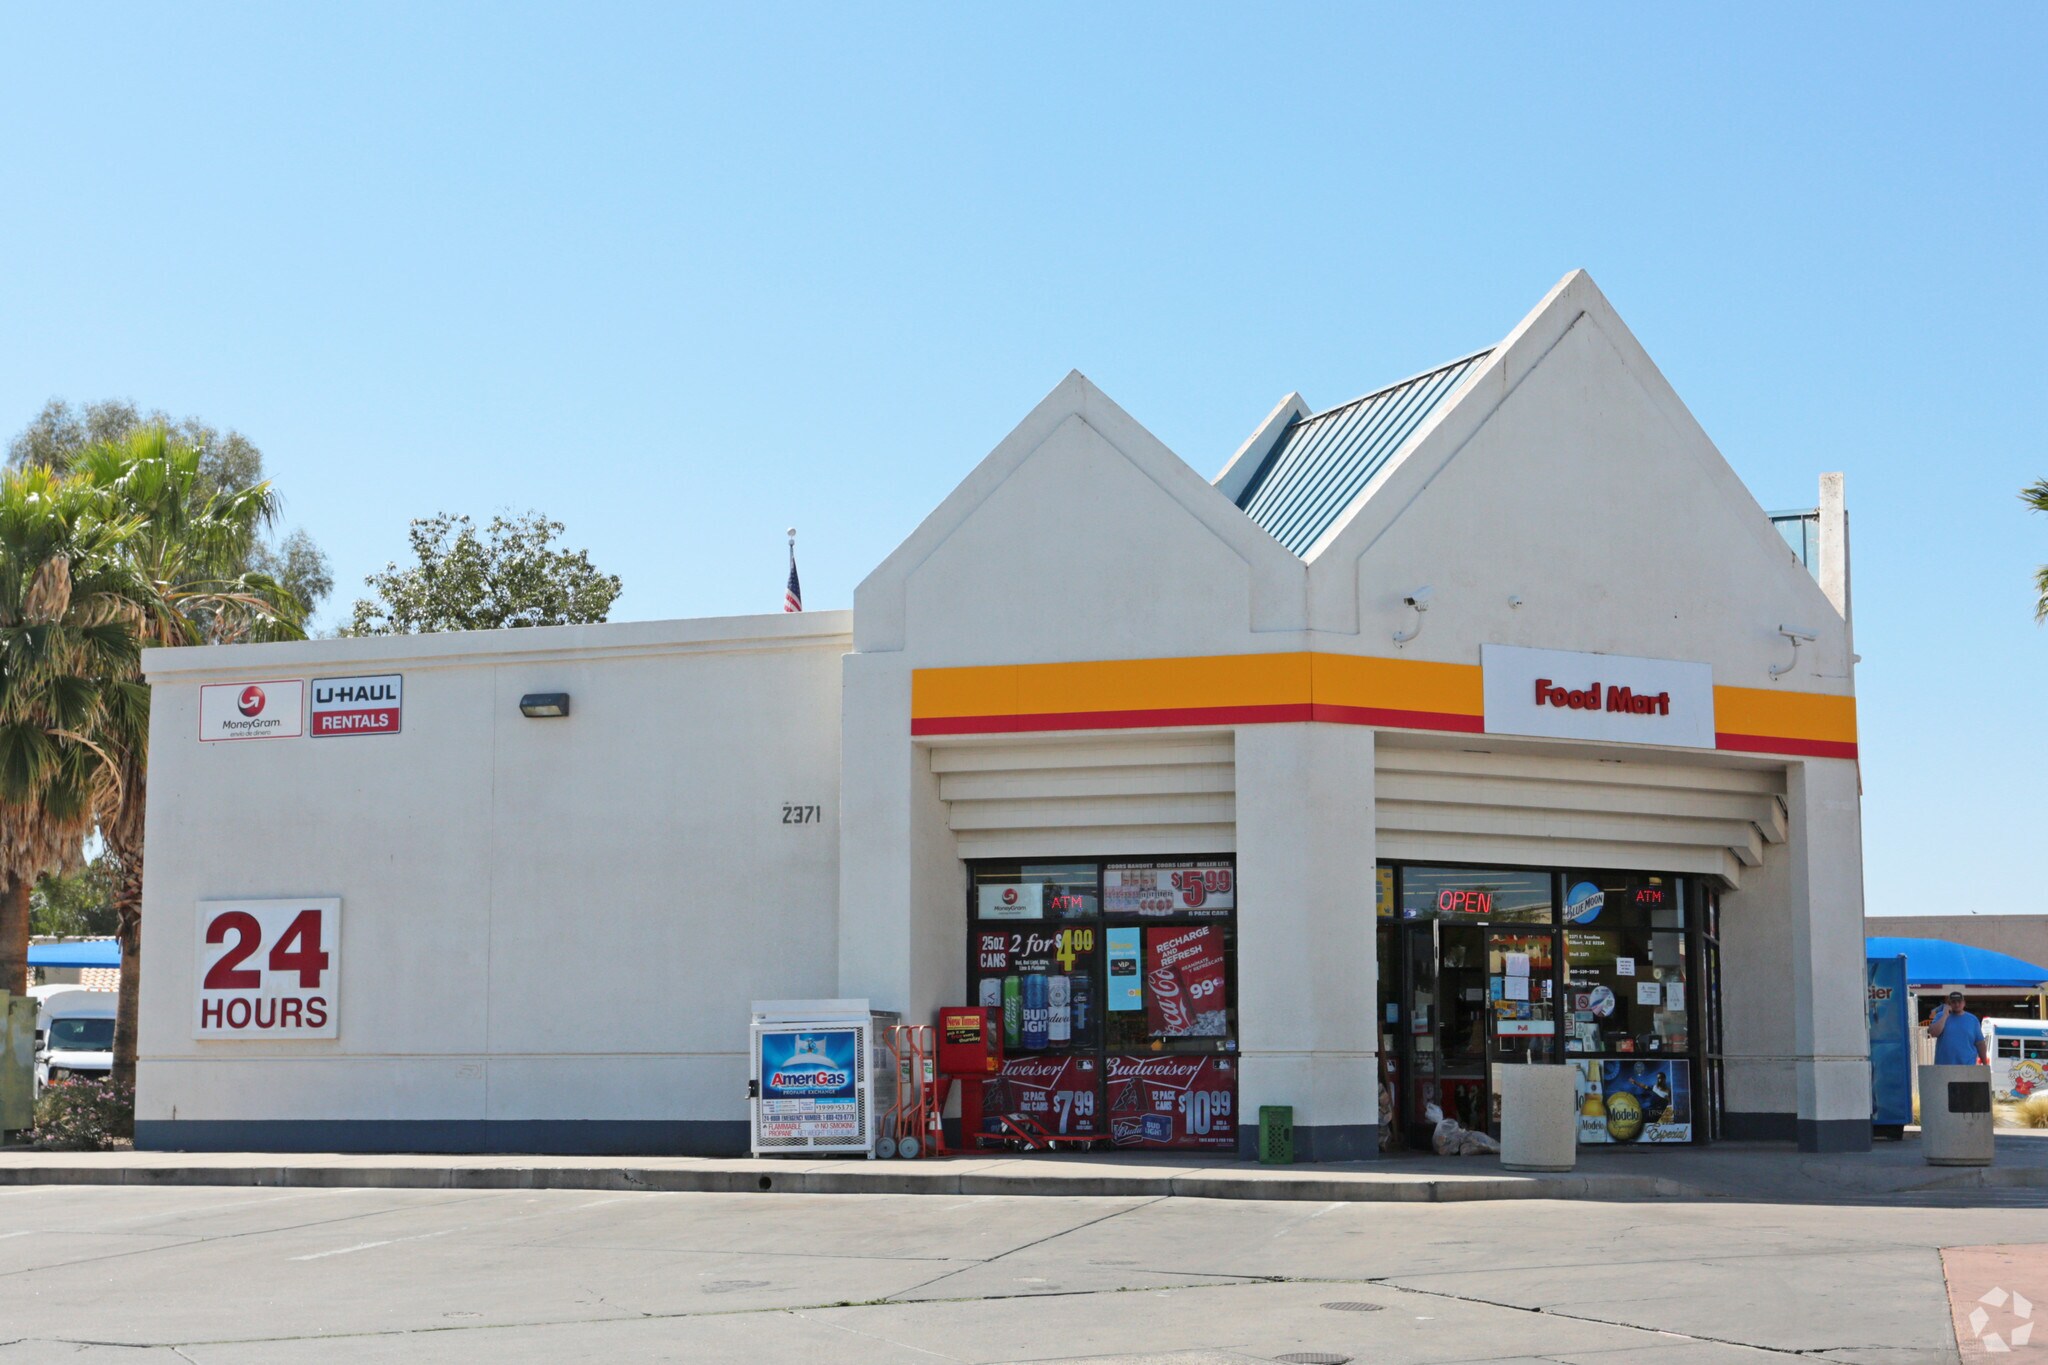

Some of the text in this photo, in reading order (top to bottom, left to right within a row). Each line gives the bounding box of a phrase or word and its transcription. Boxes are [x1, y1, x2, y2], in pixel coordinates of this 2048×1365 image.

[316, 684, 397, 704] U-HAUL
[1535, 678, 1670, 715] Food Mart
[222, 718, 281, 731] MoneyGram
[322, 713, 389, 730] RENTALS
[782, 805, 820, 824] 2371
[1051, 895, 1083, 909] ATM
[1439, 890, 1491, 913] OPEN
[1584, 894, 1605, 911] MOON
[1636, 890, 1662, 902] ATM
[1009, 934, 1021, 952] 2
[1021, 933, 1053, 957] for
[1156, 926, 1210, 954] RECHARGE
[203, 908, 329, 990] 24
[1160, 945, 1203, 967] REFRESH
[1162, 948, 1178, 958] AND
[980, 953, 1006, 968] CANS
[201, 996, 329, 1029] HOURS
[1009, 996, 1018, 1029] LIGHT
[1023, 1009, 1048, 1021] BUD
[1106, 1057, 1200, 1077] Budweiser
[771, 1071, 845, 1085] AmeriGas
[1030, 1091, 1046, 1101] PACK
[1152, 1091, 1176, 1100] 12 PACK
[1031, 1101, 1048, 1111] CANS
[1155, 1101, 1172, 1111] CANS
[1606, 1108, 1639, 1122] Modelo
[1145, 1128, 1162, 1136] LIGHT
[1146, 1121, 1160, 1129] BUD
[1582, 1120, 1605, 1131] Modelo
